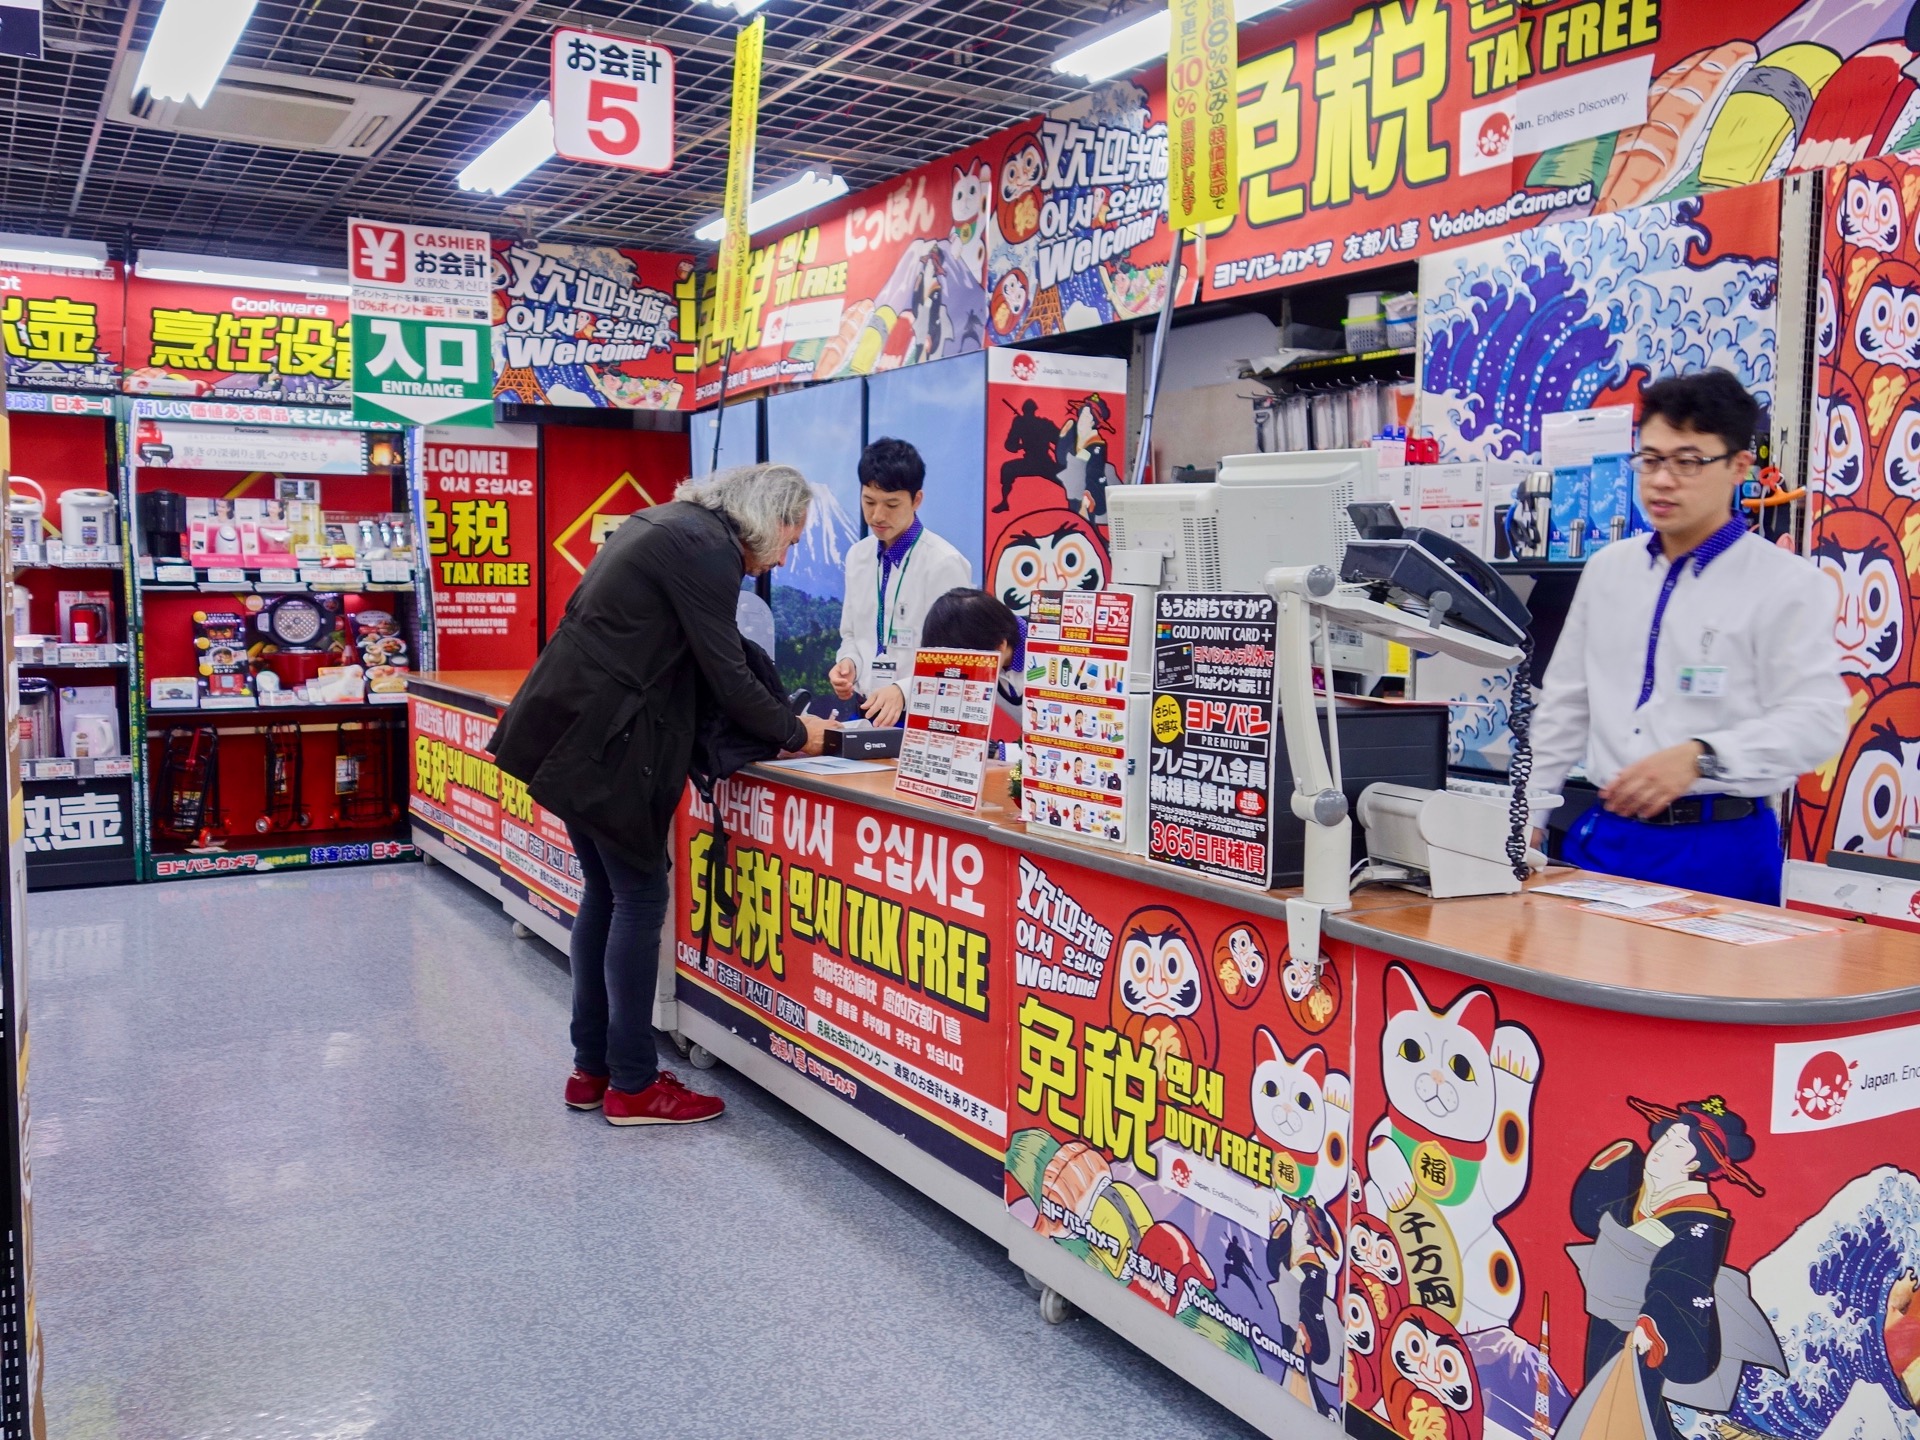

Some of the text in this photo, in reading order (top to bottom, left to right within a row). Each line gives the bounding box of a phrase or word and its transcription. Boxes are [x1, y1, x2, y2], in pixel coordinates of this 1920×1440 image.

[1541, 0, 1660, 71] FREE
[567, 37, 662, 84] お会計
[587, 79, 640, 156] 5
[1184, 0, 1450, 240] 免税
[1537, 91, 1630, 126] Endless Discovery.
[845, 175, 935, 257] にっぽん
[1039, 184, 1165, 239] 어서 오십시오
[414, 232, 486, 252] CASHIER
[1039, 210, 1157, 290] Welcome!
[1212, 240, 1334, 289] ヨドバシカメラ
[1343, 219, 1421, 263] 友都八喜
[1508, 183, 1592, 216] Camera
[414, 251, 487, 278] お会計
[801, 261, 848, 299] FREE
[231, 296, 328, 316] Cookware
[507, 247, 664, 326] 欢迎光临
[506, 304, 656, 343] 어서 오십시오
[151, 310, 351, 379] 烹饪设
[364, 320, 479, 384] 入口
[506, 336, 651, 370] Welcome!
[381, 380, 464, 397] ENTRANCE
[1042, 367, 1064, 375] Japan.
[52, 395, 113, 414] 日本一!
[214, 387, 283, 401] ヨドバシカメラ
[234, 426, 270, 434] Panasonic
[423, 447, 509, 476] ELCOME!
[440, 477, 534, 496] 어서 오십시오
[441, 562, 530, 587] TAX FREE
[1160, 598, 1273, 620] もうお持ちですか?
[1172, 624, 1200, 639] GOLD
[1201, 626, 1231, 641] POINT
[1232, 627, 1260, 642] CARD
[1155, 703, 1177, 719] さらに
[1156, 720, 1179, 735] お得な
[1185, 698, 1271, 737] ヨドバシ
[1201, 736, 1250, 751] PREMIUM
[415, 734, 447, 805] 免税
[1151, 746, 1267, 790] プレミアム会員
[1150, 773, 1236, 814] 新規募集中
[157, 854, 258, 876] ヨドバシカメラ
[310, 843, 369, 865] 接客応対
[782, 795, 835, 867] 어서
[854, 816, 986, 918] 오십시오
[1150, 820, 1266, 876] 365日間補償
[1017, 855, 1115, 960] 欢迎光临
[789, 865, 844, 950] 면세
[845, 886, 902, 977] TAX
[907, 909, 987, 1014] FREE
[1015, 917, 1104, 978] 어서 오십시오
[677, 941, 716, 980] CASHER
[717, 963, 742, 994] お会計
[745, 978, 773, 1012] 계산대
[1015, 950, 1101, 998] Welcome!
[1017, 995, 1158, 1178] 免税
[1165, 1053, 1224, 1120] 면세
[1860, 1073, 1898, 1091] Japan.
[1164, 1103, 1272, 1189] DUTY FREE
[1278, 1160, 1295, 1184] 福
[1420, 1152, 1447, 1187] 福
[1041, 1196, 1306, 1374] ヨドバシカメラ 友都八喜 Yodobashi Camera
